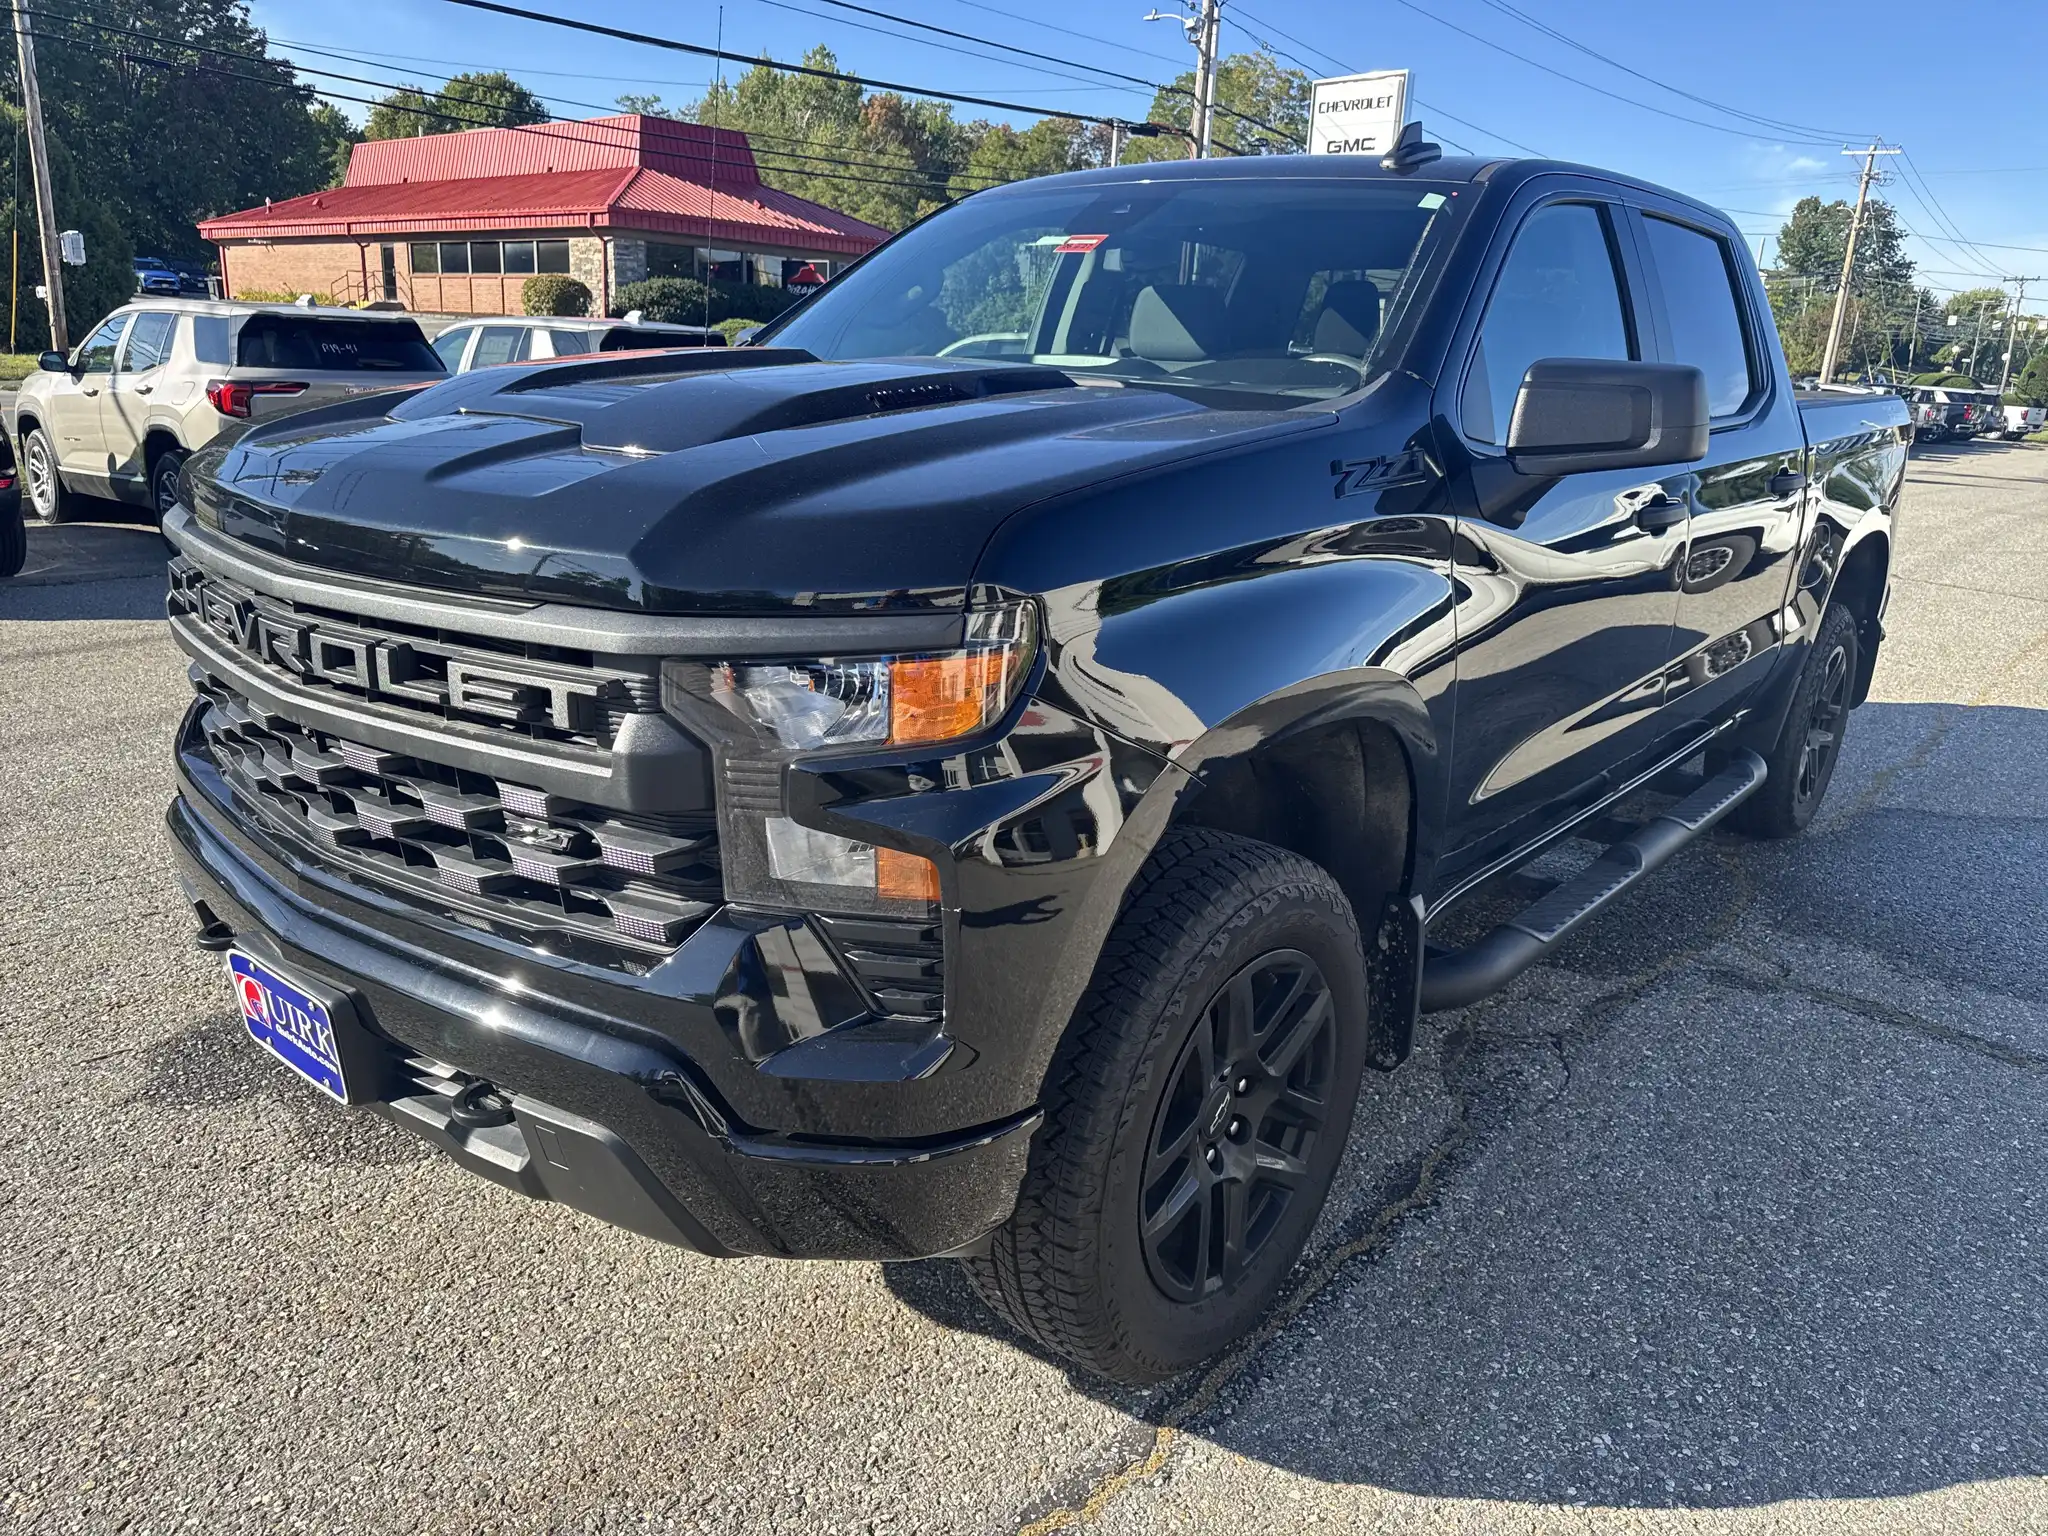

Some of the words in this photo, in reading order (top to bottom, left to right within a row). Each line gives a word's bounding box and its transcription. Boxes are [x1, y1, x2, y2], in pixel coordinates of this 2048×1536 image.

[1318, 95, 1393, 114] CHEVROLET
[1326, 137, 1376, 154] GMC
[168, 559, 612, 730] CHEVROLET
[238, 977, 339, 1066] QUIRK
